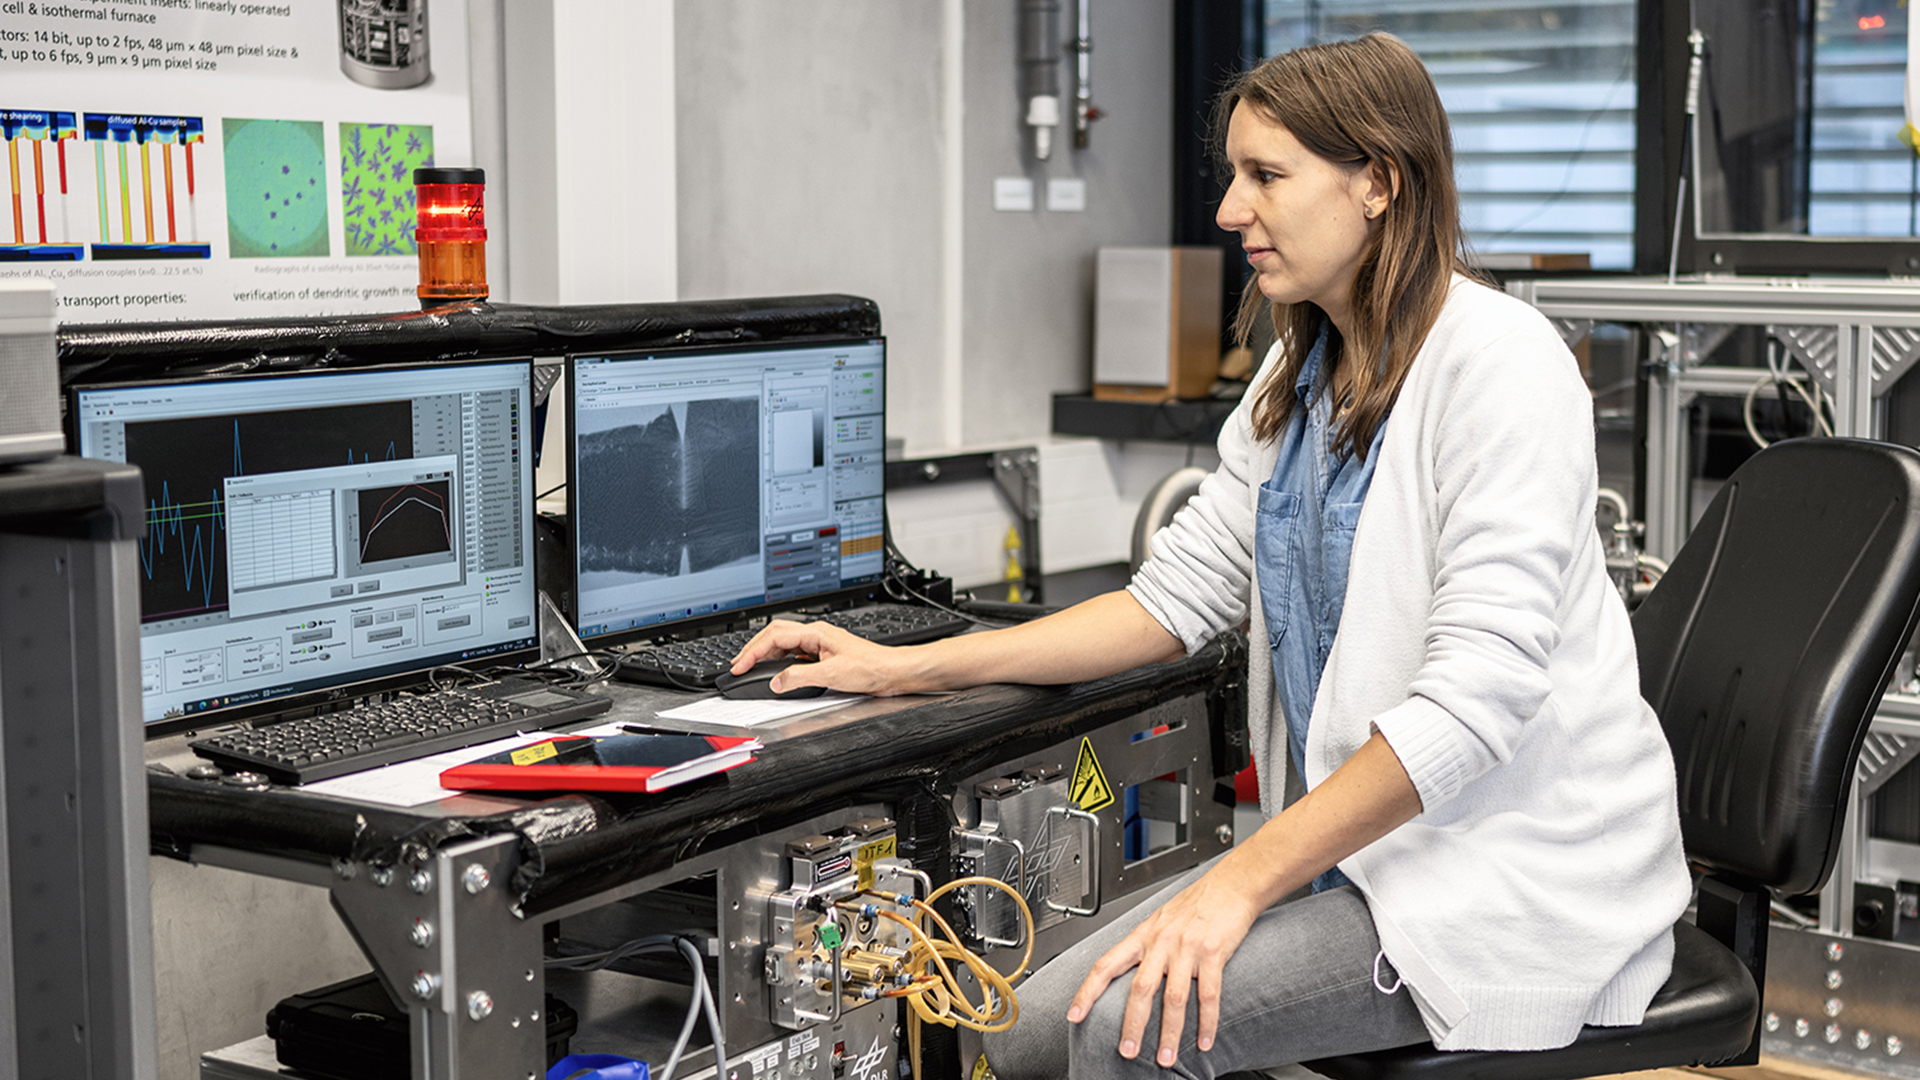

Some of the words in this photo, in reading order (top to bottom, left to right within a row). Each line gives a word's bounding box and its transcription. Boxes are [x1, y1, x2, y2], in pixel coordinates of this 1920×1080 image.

[2, 1, 24, 14] cell
[28, 2, 38, 16] &
[41, 3, 107, 21] isothermal
[111, 8, 157, 25] furnace
[195, 0, 237, 16] linearly
[240, 4, 291, 17] operated
[0, 29, 30, 43] tors:
[34, 30, 49, 43] 14
[52, 31, 74, 47] bit,
[76, 35, 93, 49] up
[96, 35, 110, 48] to
[113, 35, 121, 48] 2
[124, 35, 146, 52] fps,
[148, 37, 163, 51] 48
[199, 41, 213, 54] 48
[237, 44, 264, 58] pixel
[266, 45, 288, 58] size
[291, 47, 299, 59] &
[11, 49, 29, 62] up
[32, 50, 46, 61] to
[49, 49, 58, 62] 6
[61, 49, 83, 65] fps,
[86, 51, 94, 64] 9
[131, 54, 139, 67] 9
[164, 56, 192, 71] pixel
[195, 58, 217, 71] size
[9, 112, 43, 122] shearing
[107, 116, 137, 125] diffused
[159, 118, 188, 127] samples
[22, 268, 31, 278] of
[67, 267, 105, 278] diffusion
[105, 266, 137, 278] couples
[63, 293, 121, 309] transport
[123, 290, 188, 307] properties:
[233, 288, 296, 302] verification
[298, 288, 309, 300] of
[312, 287, 359, 300] dendritic
[361, 285, 399, 301] growth
